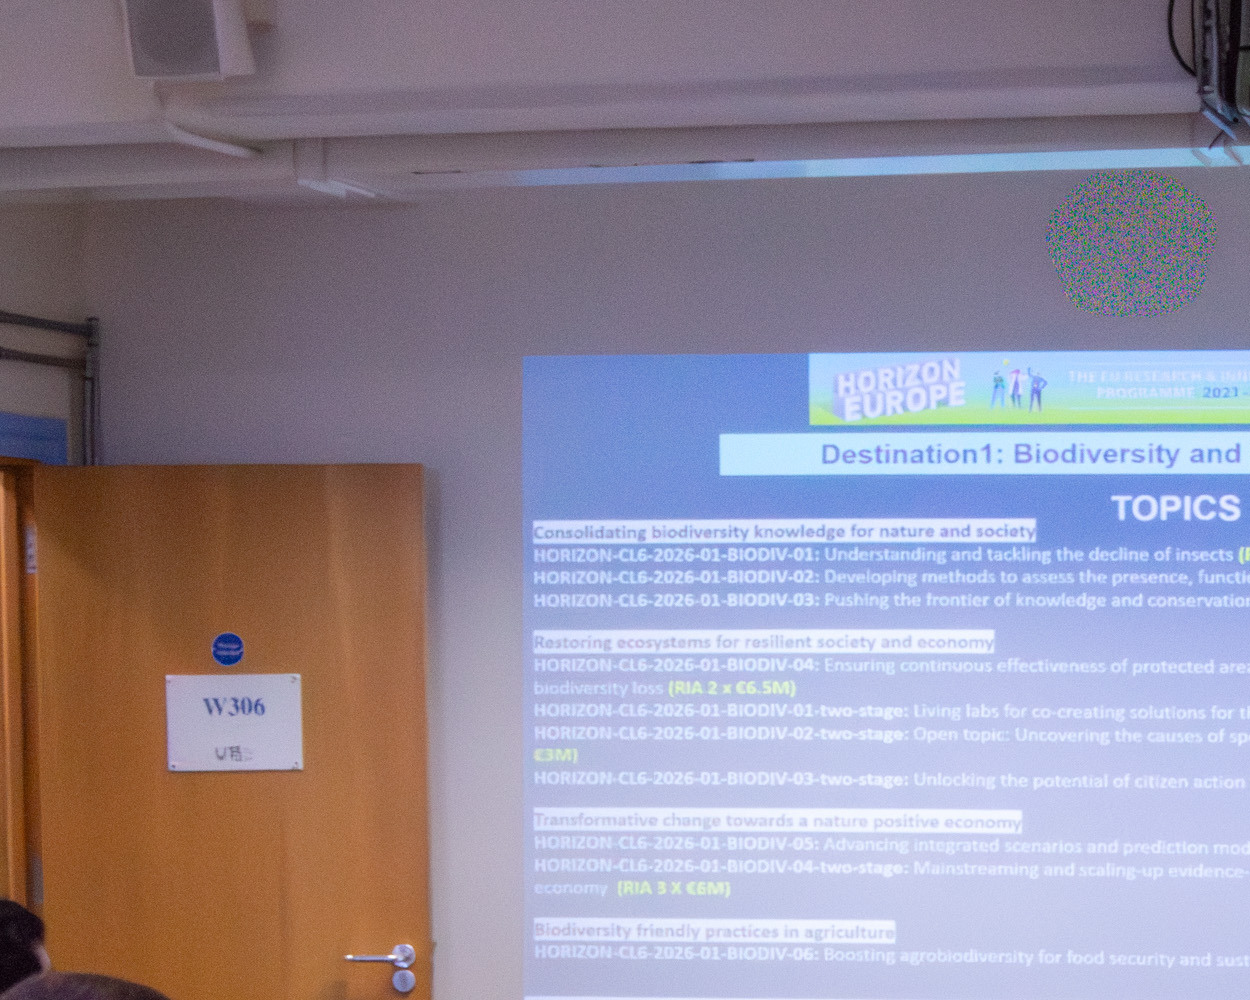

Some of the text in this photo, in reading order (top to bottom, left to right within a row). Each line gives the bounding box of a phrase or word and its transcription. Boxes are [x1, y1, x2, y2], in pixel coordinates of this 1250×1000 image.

[837, 358, 961, 398] HORIZON
[1069, 370, 1096, 383] THE
[1124, 370, 1201, 383] RESEARCH
[843, 381, 967, 422] EUROPE
[1096, 386, 1196, 400] PROGRAMME
[1202, 386, 1240, 399] 2021
[821, 443, 1004, 465] Destination1:
[1013, 443, 1180, 469] Biodiversity
[1189, 443, 1242, 464] and
[1110, 493, 1242, 522] TOPICS
[532, 523, 1035, 542] Consolidating biodiversity knowledge nature society
[823, 547, 947, 564] Understanding
[986, 547, 1051, 564] tackling
[1088, 547, 1149, 561] decline
[1175, 547, 1233, 562] insects
[823, 569, 918, 586] Developing
[921, 569, 996, 584] methods
[1021, 573, 1074, 584] assess
[1111, 573, 1193, 587] presence,
[824, 592, 890, 610] Pushing
[926, 592, 990, 607] frontier
[1015, 593, 1107, 610] knowledge
[534, 634, 994, 652] Restoring ecosystems resilient society economy
[825, 656, 895, 674] Ensuring
[898, 657, 994, 672] continuous
[995, 658, 1107, 673] effectiveness
[1131, 659, 1215, 676] protected
[534, 680, 628, 698] biodiversity
[632, 680, 663, 695] loss
[668, 679, 703, 697] (RIA
[202, 696, 266, 717] W306
[913, 703, 962, 721] Living
[965, 704, 999, 718] labs
[1031, 704, 1125, 722] co-creating
[1129, 705, 1206, 720] solutions
[912, 727, 959, 744] Open
[962, 726, 1010, 744] topic:
[1014, 727, 1110, 745] Uncovering
[1146, 732, 1203, 743] causes
[912, 772, 996, 790] Unlocking
[1032, 773, 1109, 791] potential
[1134, 774, 1188, 789] citizen
[1193, 774, 1245, 789] action
[534, 811, 1020, 832] Transformative change towards nature positive economy
[822, 836, 910, 854] Advancing
[912, 837, 1000, 855] integrated
[1004, 838, 1083, 853] scenarios
[1122, 839, 1209, 857] prediction
[913, 859, 1041, 878] Mainstreaming
[1078, 862, 1165, 880] scaling-up
[534, 883, 608, 897] economy
[636, 923, 701, 941] friendly
[705, 923, 779, 941] practices
[803, 924, 894, 943] agriculture
[823, 946, 896, 964] Boosting
[1067, 950, 1105, 965] food
[1109, 950, 1176, 969] security
